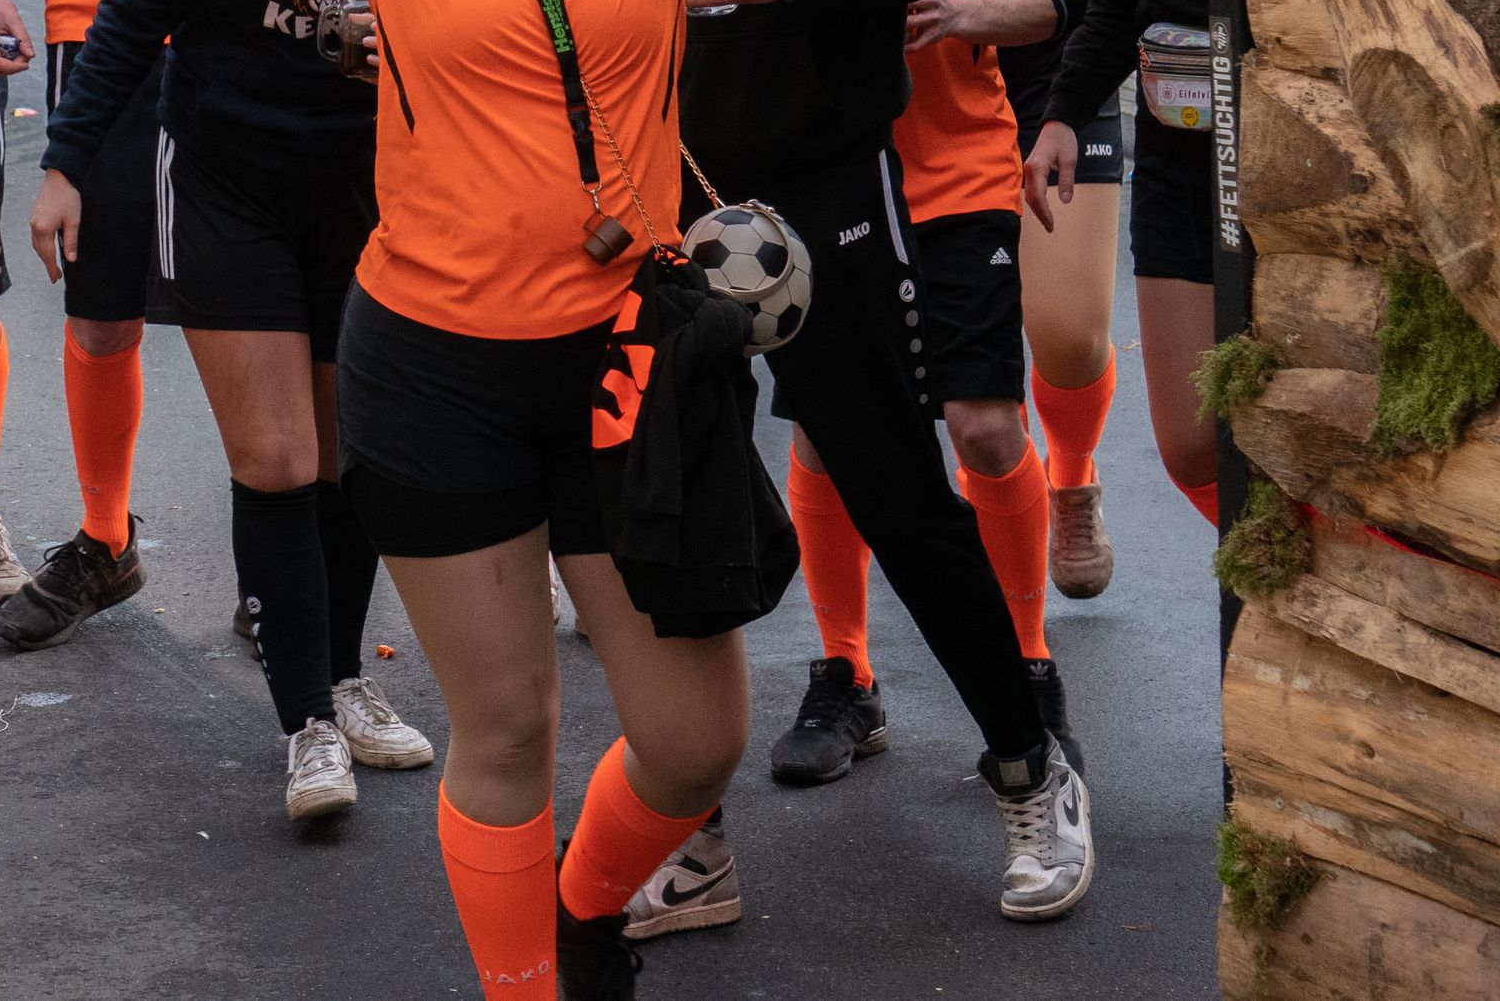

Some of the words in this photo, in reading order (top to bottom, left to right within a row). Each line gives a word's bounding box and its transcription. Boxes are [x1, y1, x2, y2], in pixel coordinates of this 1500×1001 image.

[1085, 144, 1112, 156] JAKO
[1213, 57, 1240, 248] #FETTSÜCHTIG
[839, 221, 870, 245] JAKO
[484, 960, 549, 984] JAKO
